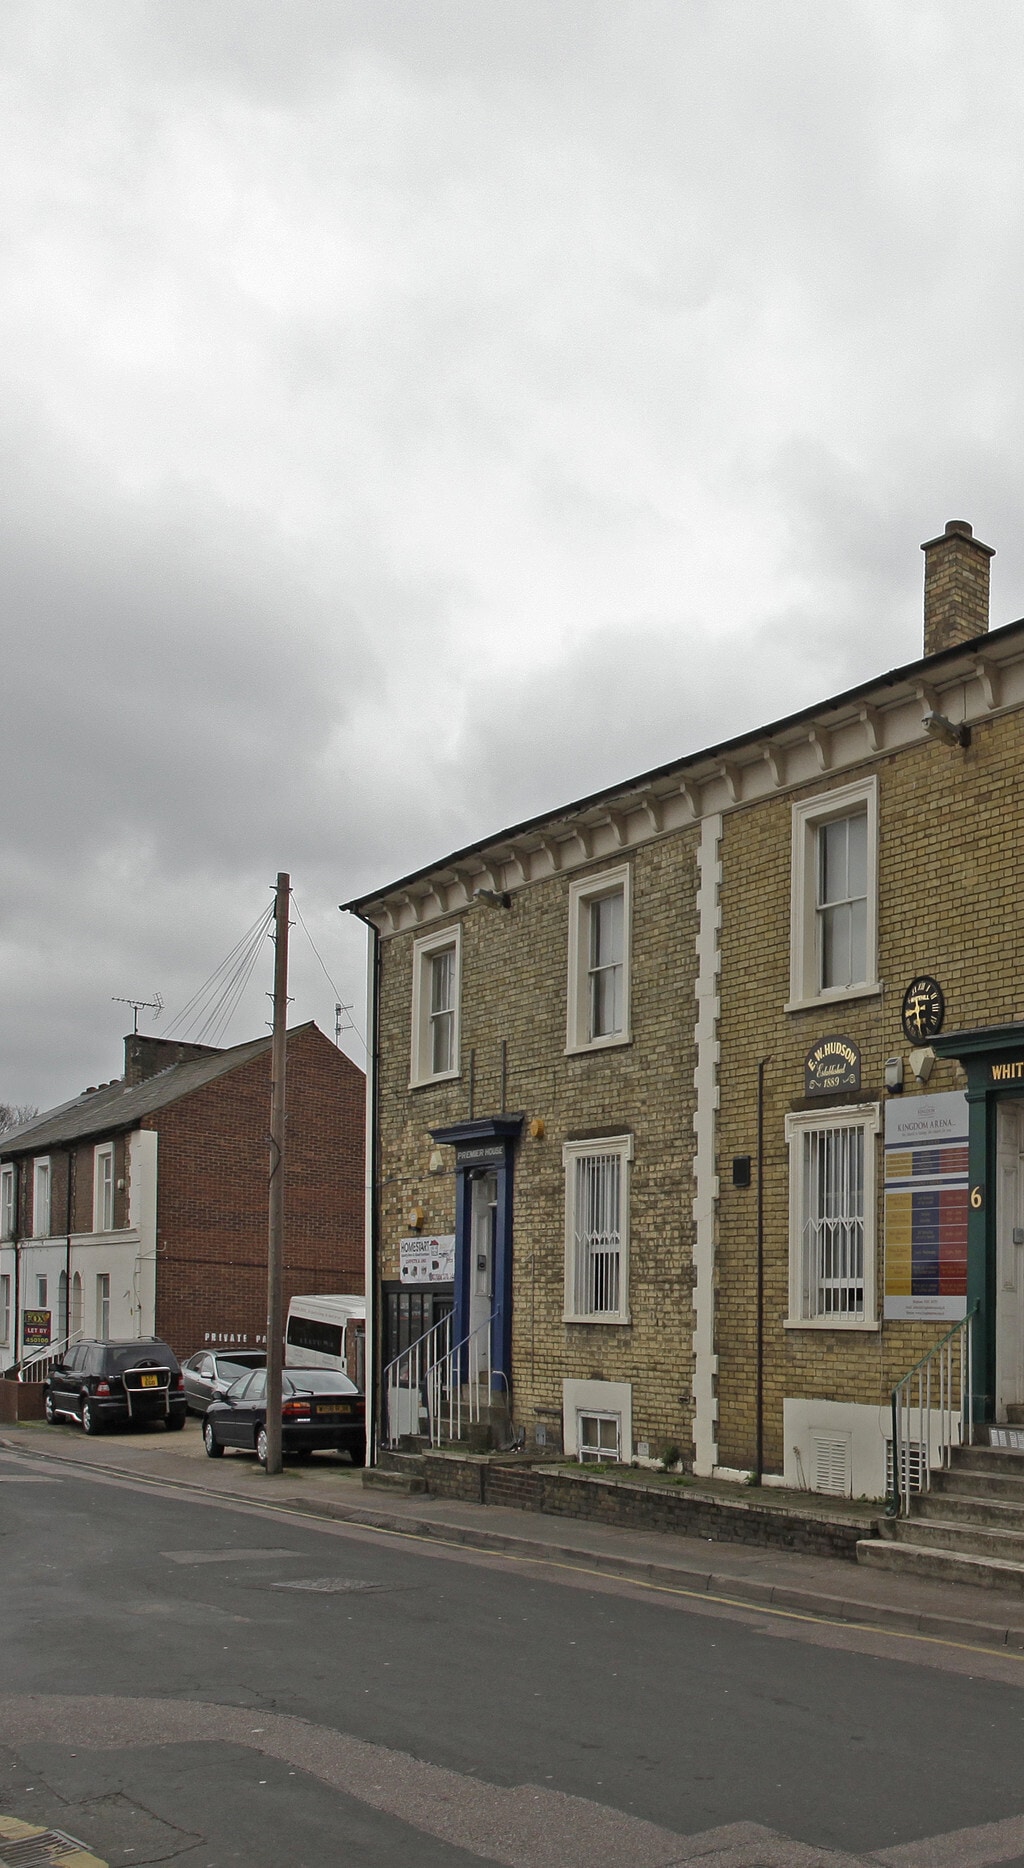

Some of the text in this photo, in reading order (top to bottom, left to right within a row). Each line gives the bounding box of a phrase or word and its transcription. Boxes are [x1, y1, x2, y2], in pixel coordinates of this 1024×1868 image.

[897, 1121, 928, 1133] KINGDOM
[457, 1146, 503, 1160] PREMIER HOUSE
[971, 1186, 982, 1208] 6
[204, 1332, 248, 1343] PRIVATE
